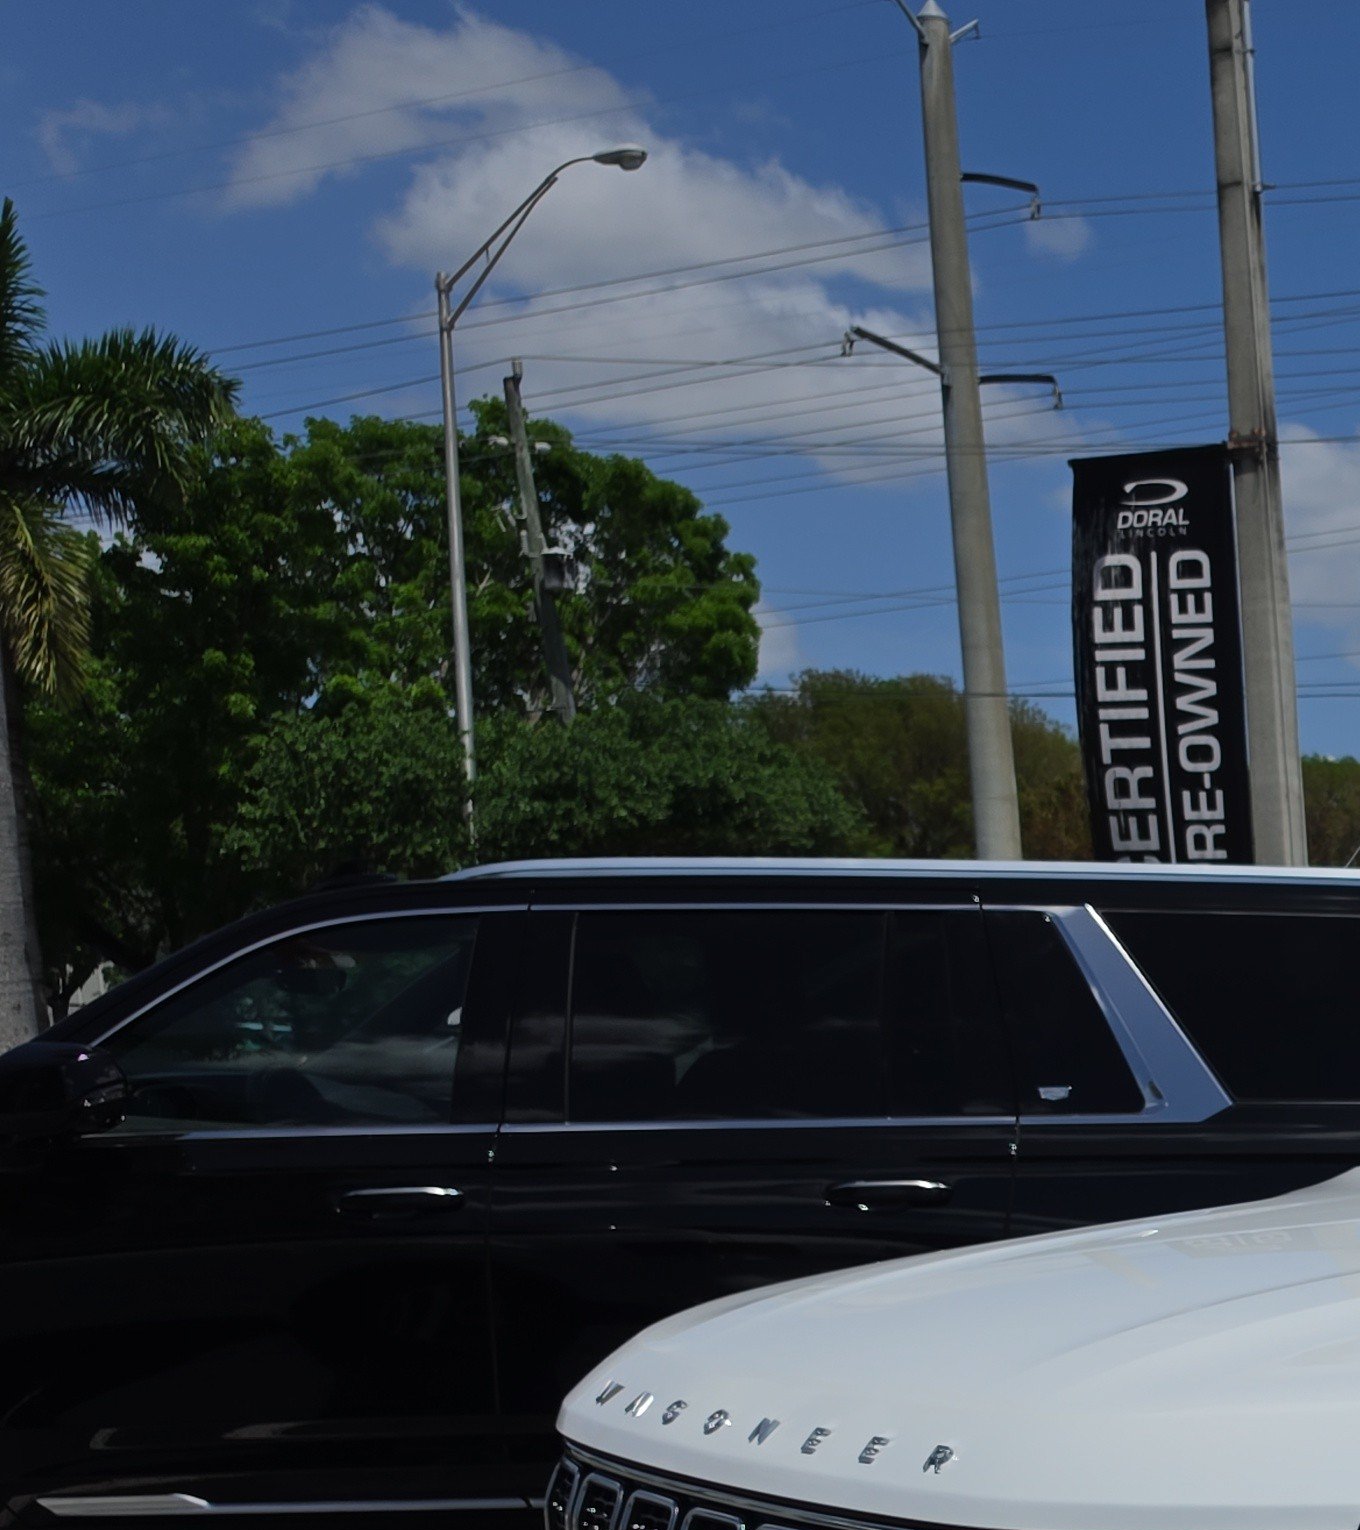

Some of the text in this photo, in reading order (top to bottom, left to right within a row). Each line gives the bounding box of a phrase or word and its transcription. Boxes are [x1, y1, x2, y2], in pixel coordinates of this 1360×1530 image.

[1117, 508, 1190, 529] DORAL
[1093, 553, 1160, 862] ERTIFIED
[1168, 550, 1228, 860] RE-OWNED
[596, 1379, 954, 1474] WAGONEER
